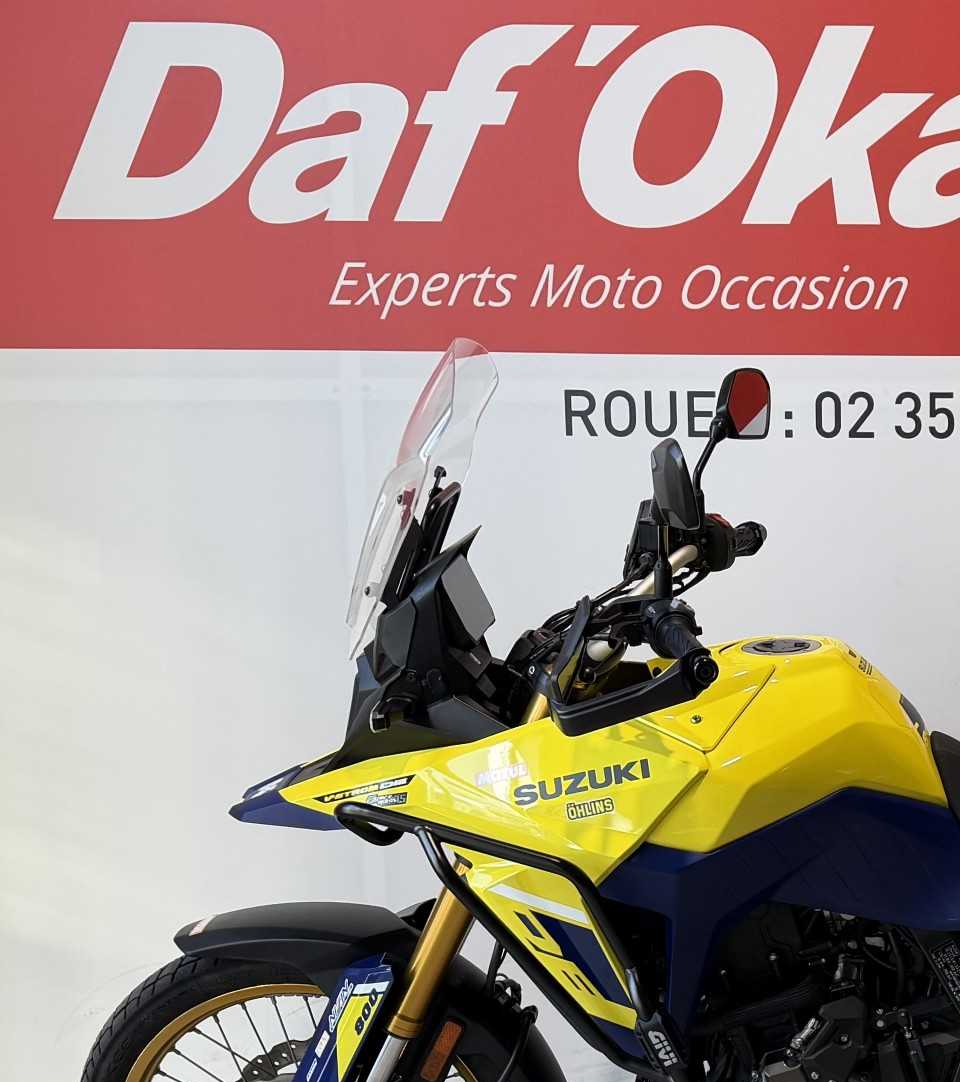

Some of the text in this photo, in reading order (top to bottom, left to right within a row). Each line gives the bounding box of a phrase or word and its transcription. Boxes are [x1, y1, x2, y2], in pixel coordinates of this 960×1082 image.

[328, 261, 909, 320] Experts Moto Occasion
[564, 388, 720, 438] ROUE
[815, 390, 875, 439] 02
[894, 391, 955, 440] 35
[514, 758, 650, 806] SUZUKI
[567, 798, 614, 820] ÖHLINS
[355, 988, 379, 1036] 800
